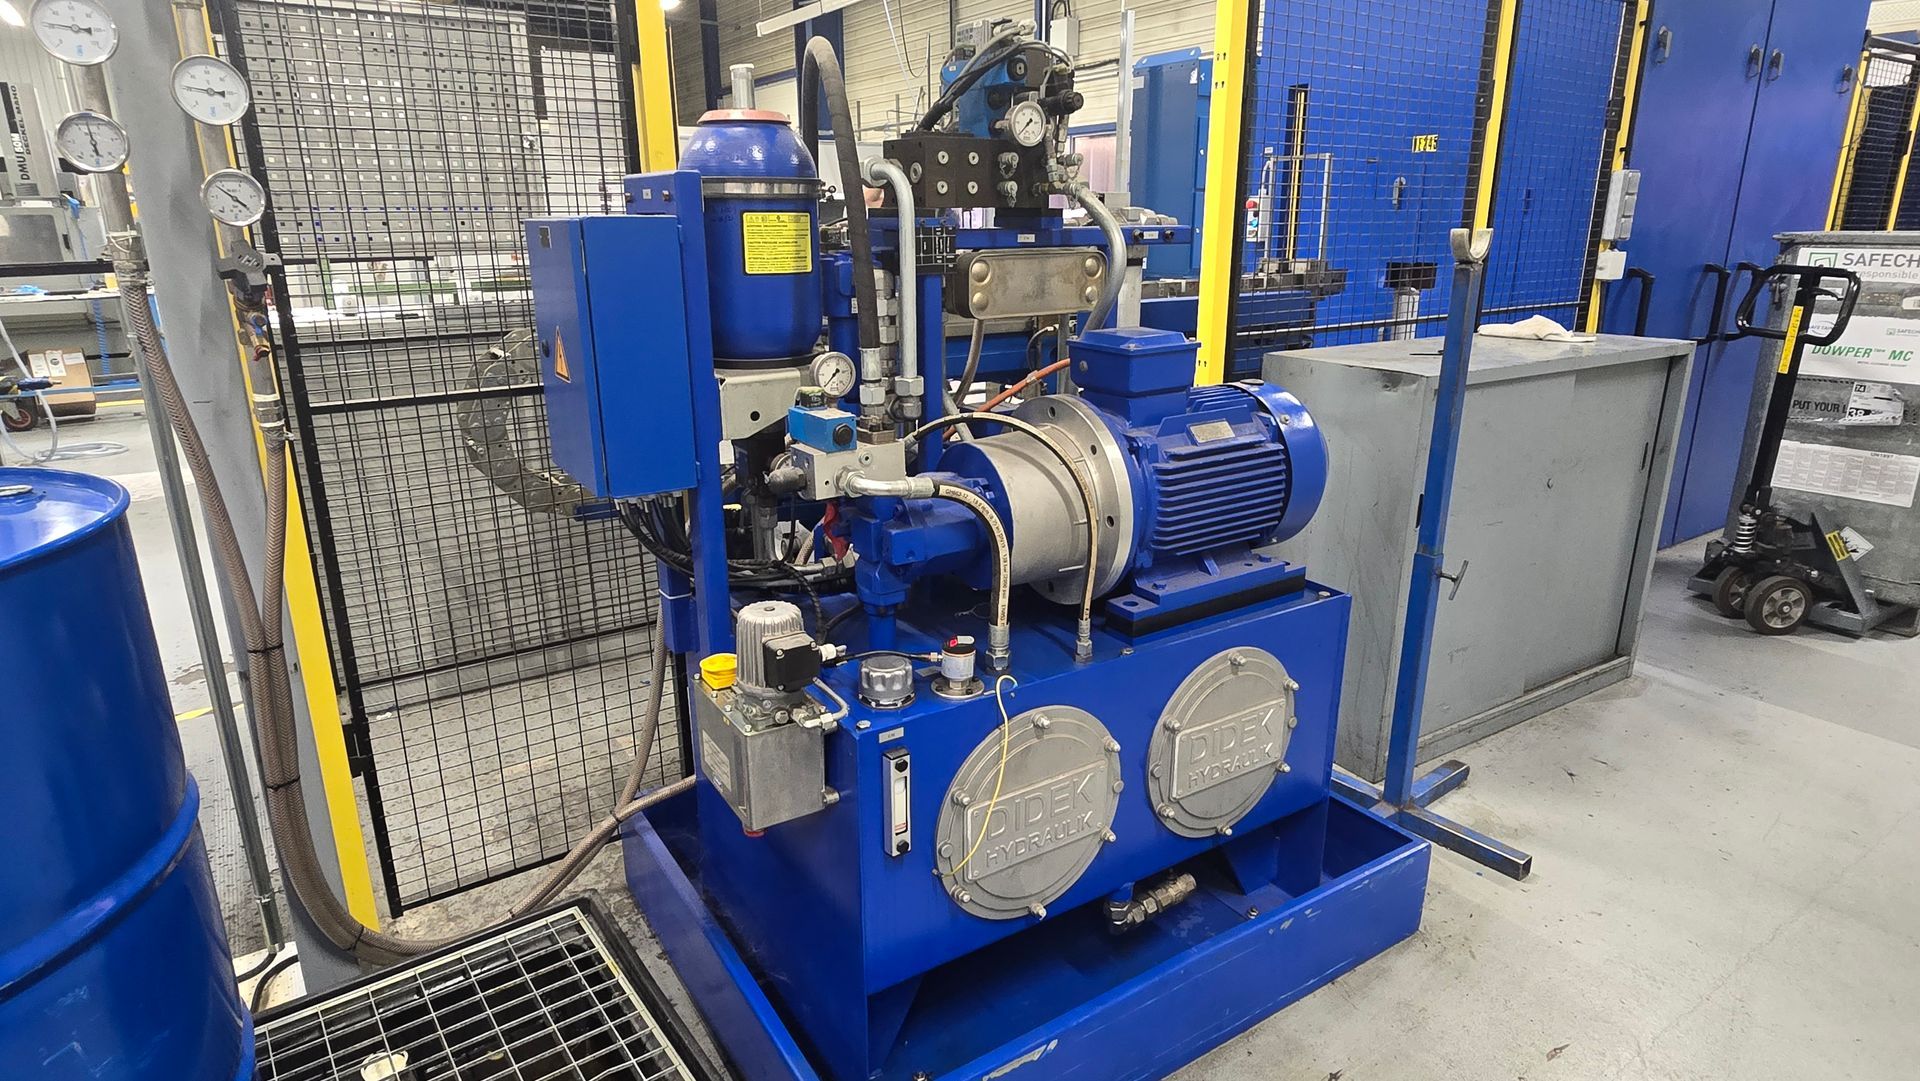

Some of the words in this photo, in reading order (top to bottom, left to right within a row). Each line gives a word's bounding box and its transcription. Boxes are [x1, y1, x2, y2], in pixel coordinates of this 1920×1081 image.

[10, 85, 22, 115] MAHO
[19, 119, 31, 155] DECKEL
[15, 155, 30, 181] DMU
[1888, 350, 1914, 361] MC
[1792, 400, 1811, 410] PUT
[1814, 402, 1840, 412] YOUR
[1190, 708, 1275, 764] DIDEK
[1188, 742, 1273, 789] HYDRAULIK
[986, 772, 1094, 841] DIDEK
[986, 810, 1093, 867] HYDRAULIK
